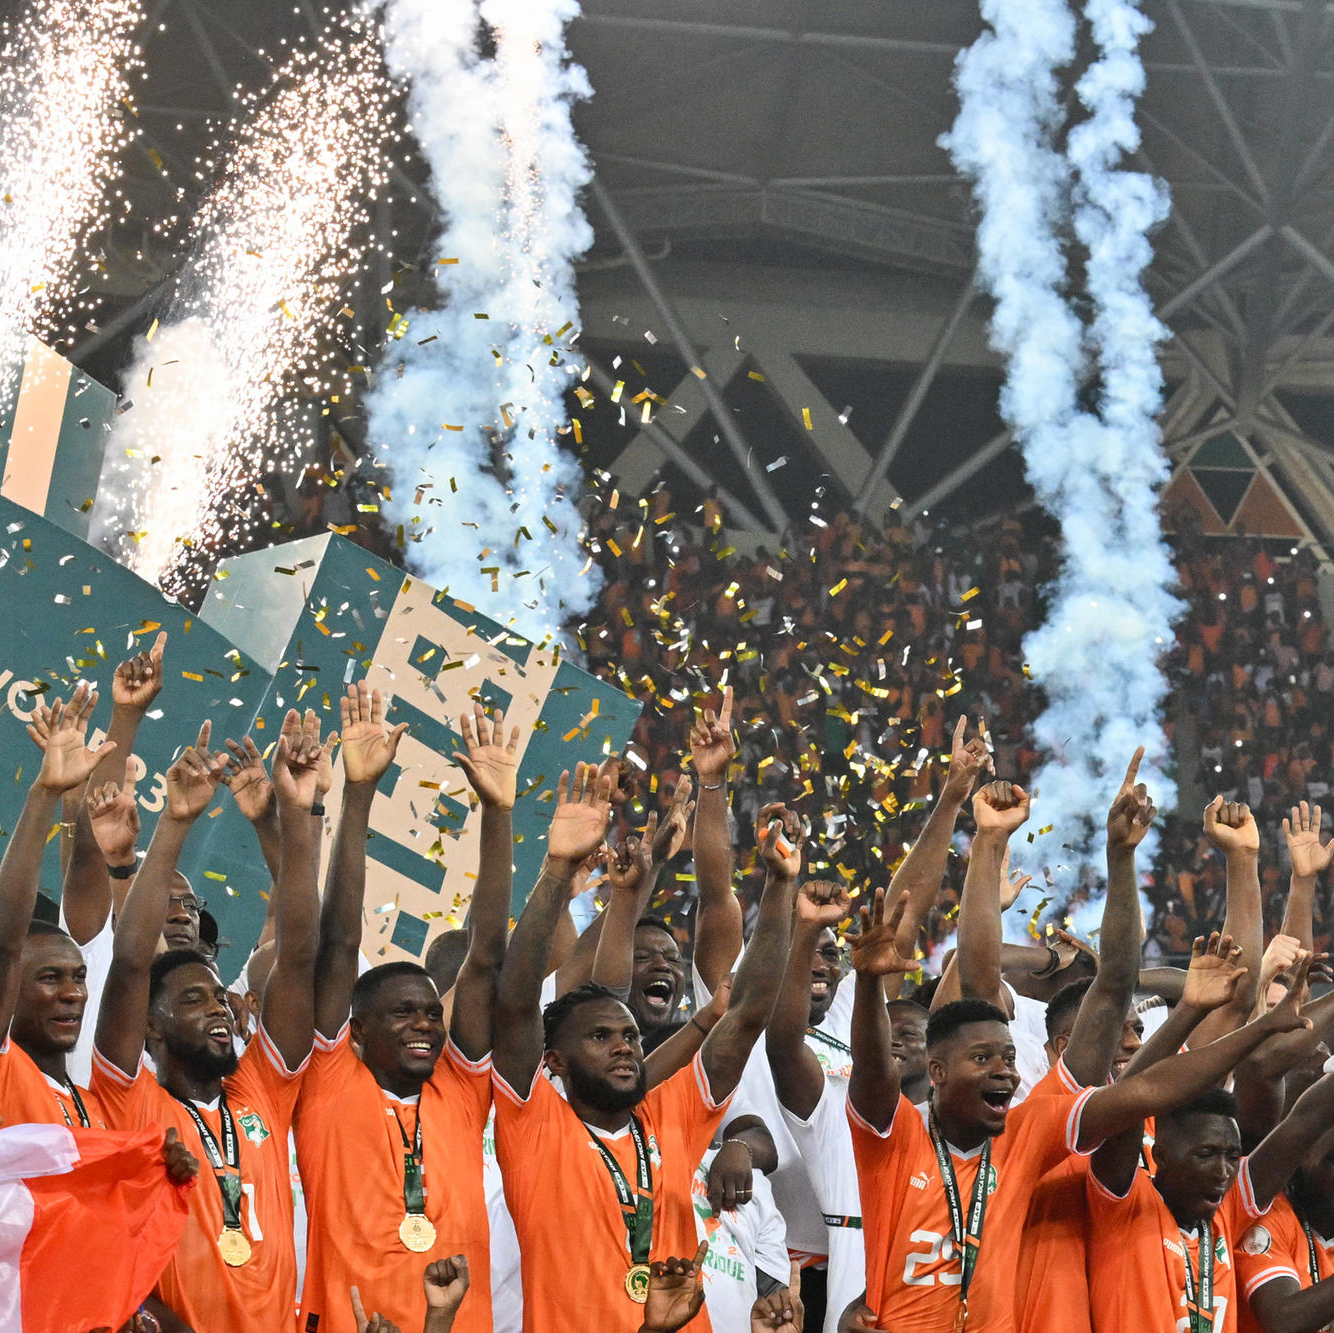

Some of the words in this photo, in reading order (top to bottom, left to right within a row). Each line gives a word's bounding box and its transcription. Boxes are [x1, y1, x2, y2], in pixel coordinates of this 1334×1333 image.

[944, 1173, 953, 1186] CUP
[978, 1167, 986, 1180] CUP
[947, 1185, 957, 1207] AFRICA
[975, 1179, 985, 1201] AFRICA
